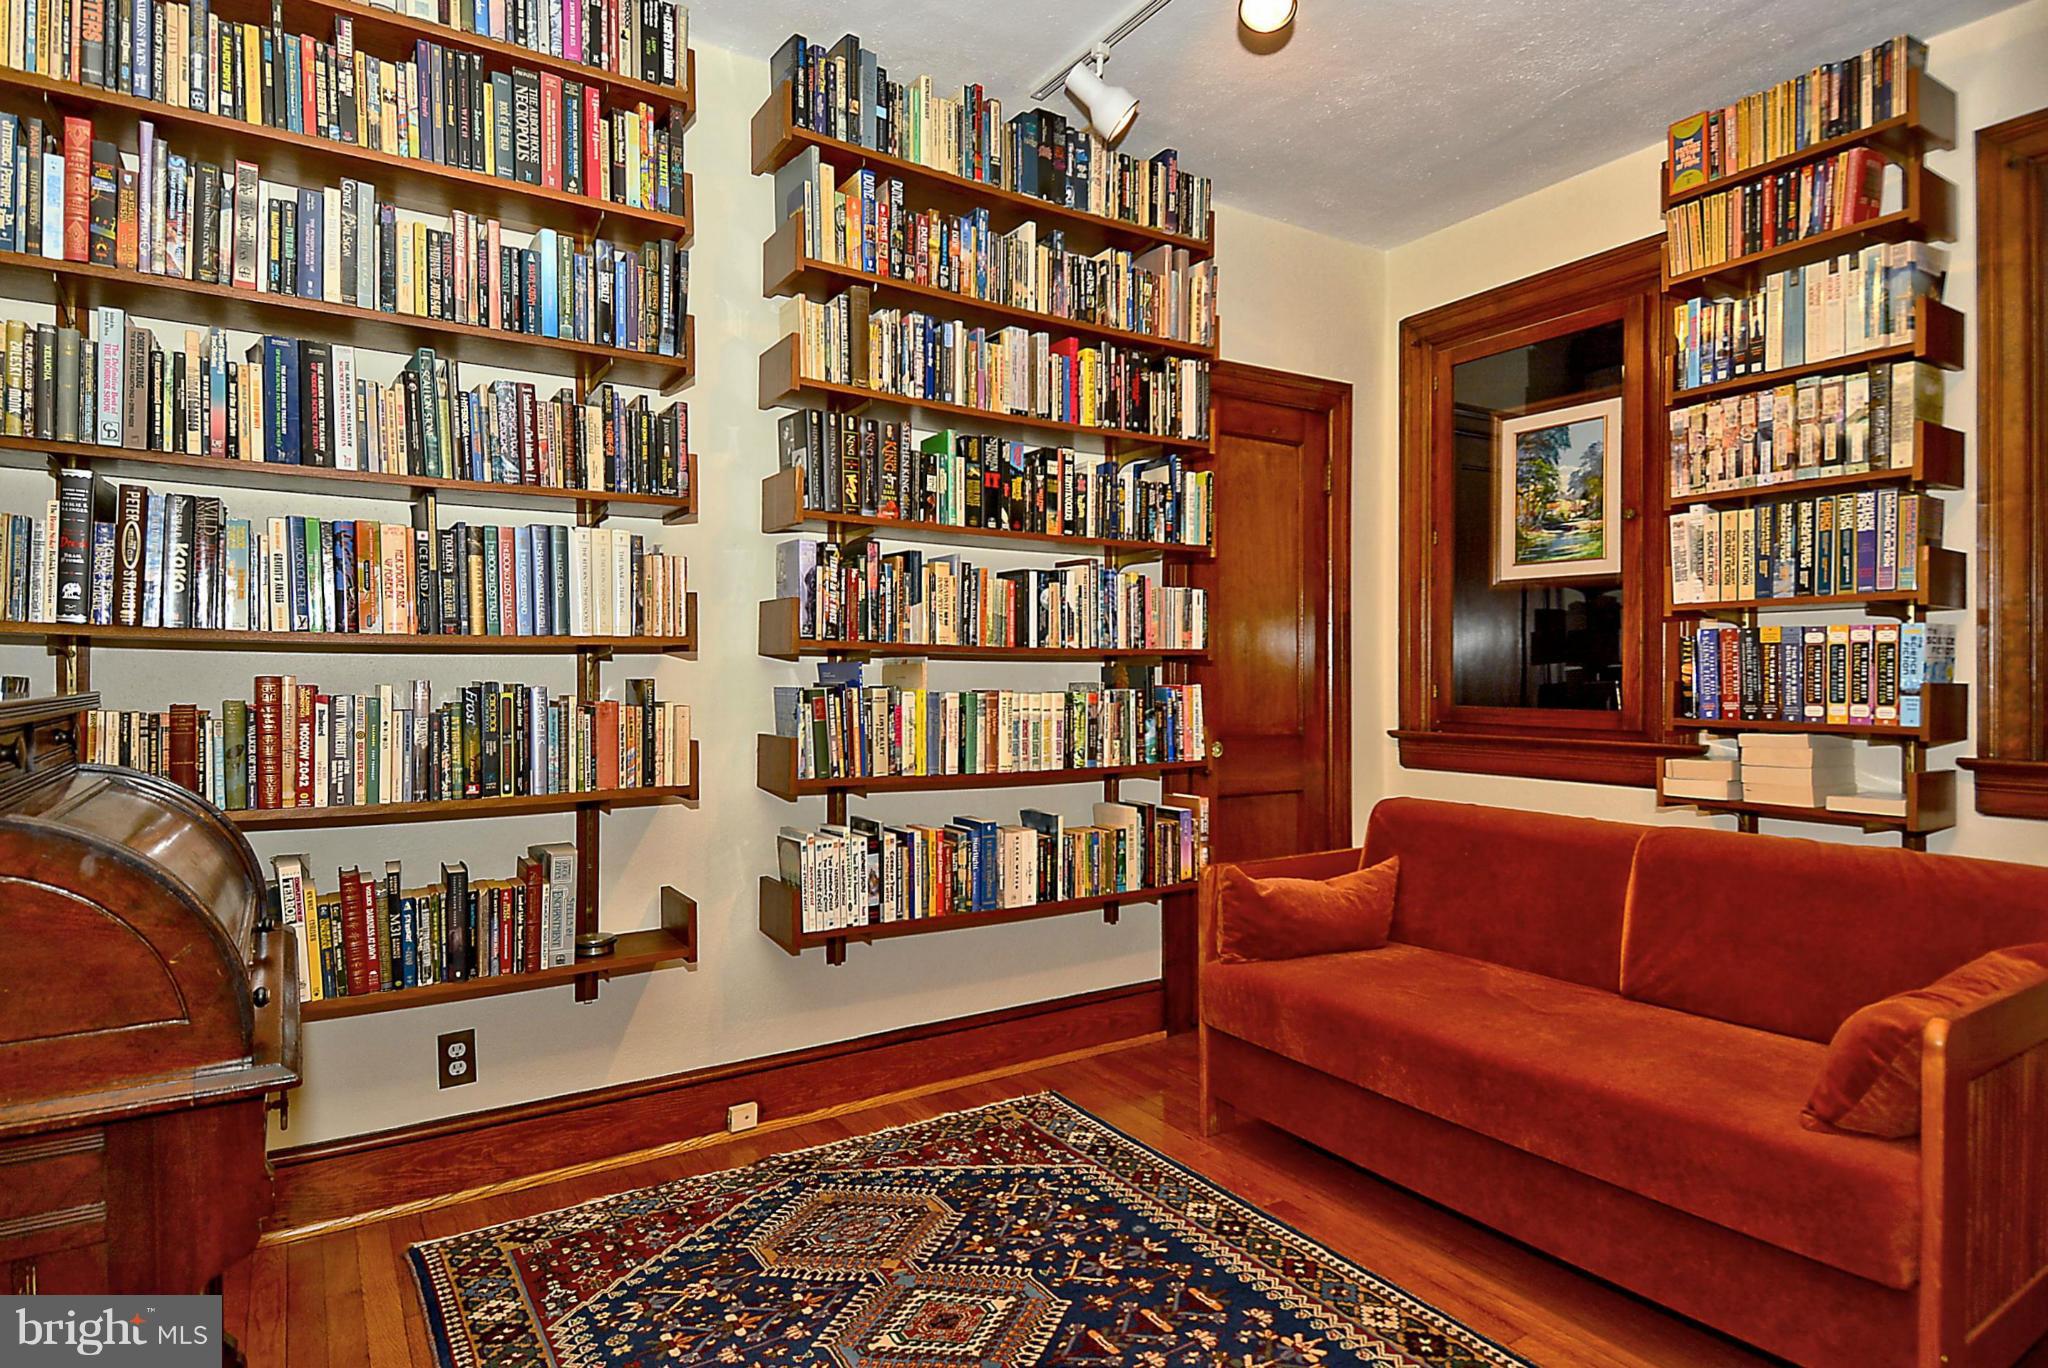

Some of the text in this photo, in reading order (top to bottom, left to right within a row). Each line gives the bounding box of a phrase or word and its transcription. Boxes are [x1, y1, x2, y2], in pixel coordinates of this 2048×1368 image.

[222, 36, 231, 91] HARD DRIVE
[516, 85, 528, 161] NECROPOLIS
[30, 125, 39, 158] PAVANE
[1, 169, 12, 208] PERFUME
[863, 174, 874, 199] DUNE
[891, 181, 903, 205] DUNE
[601, 272, 609, 304] SHECKLEY
[10, 341, 21, 375] ZALESKI
[43, 345, 51, 380] XELUCHA
[847, 435, 856, 455] KING
[865, 432, 875, 455] KING
[884, 441, 896, 472] KING
[901, 426, 910, 493] STEPHEN KING
[989, 438, 999, 472] STEPHEN
[203, 500, 218, 535] WILD
[122, 492, 139, 607] PETER STRAUB
[419, 544, 428, 590] ICE LAND
[1707, 530, 1715, 585] SCIENCE FICTION
[1724, 530, 1732, 585] SCIENCE FICTION
[1742, 530, 1750, 585] SCIENCE FICTION
[174, 543, 188, 593] KOKO
[335, 697, 347, 717] KURT
[465, 691, 478, 725] Frost
[248, 726, 256, 753] WALKER
[300, 724, 309, 787] MOSCOW 2042
[335, 718, 347, 758] VONNEGUT
[283, 881, 295, 923] TERROR
[390, 914, 400, 937] M31
